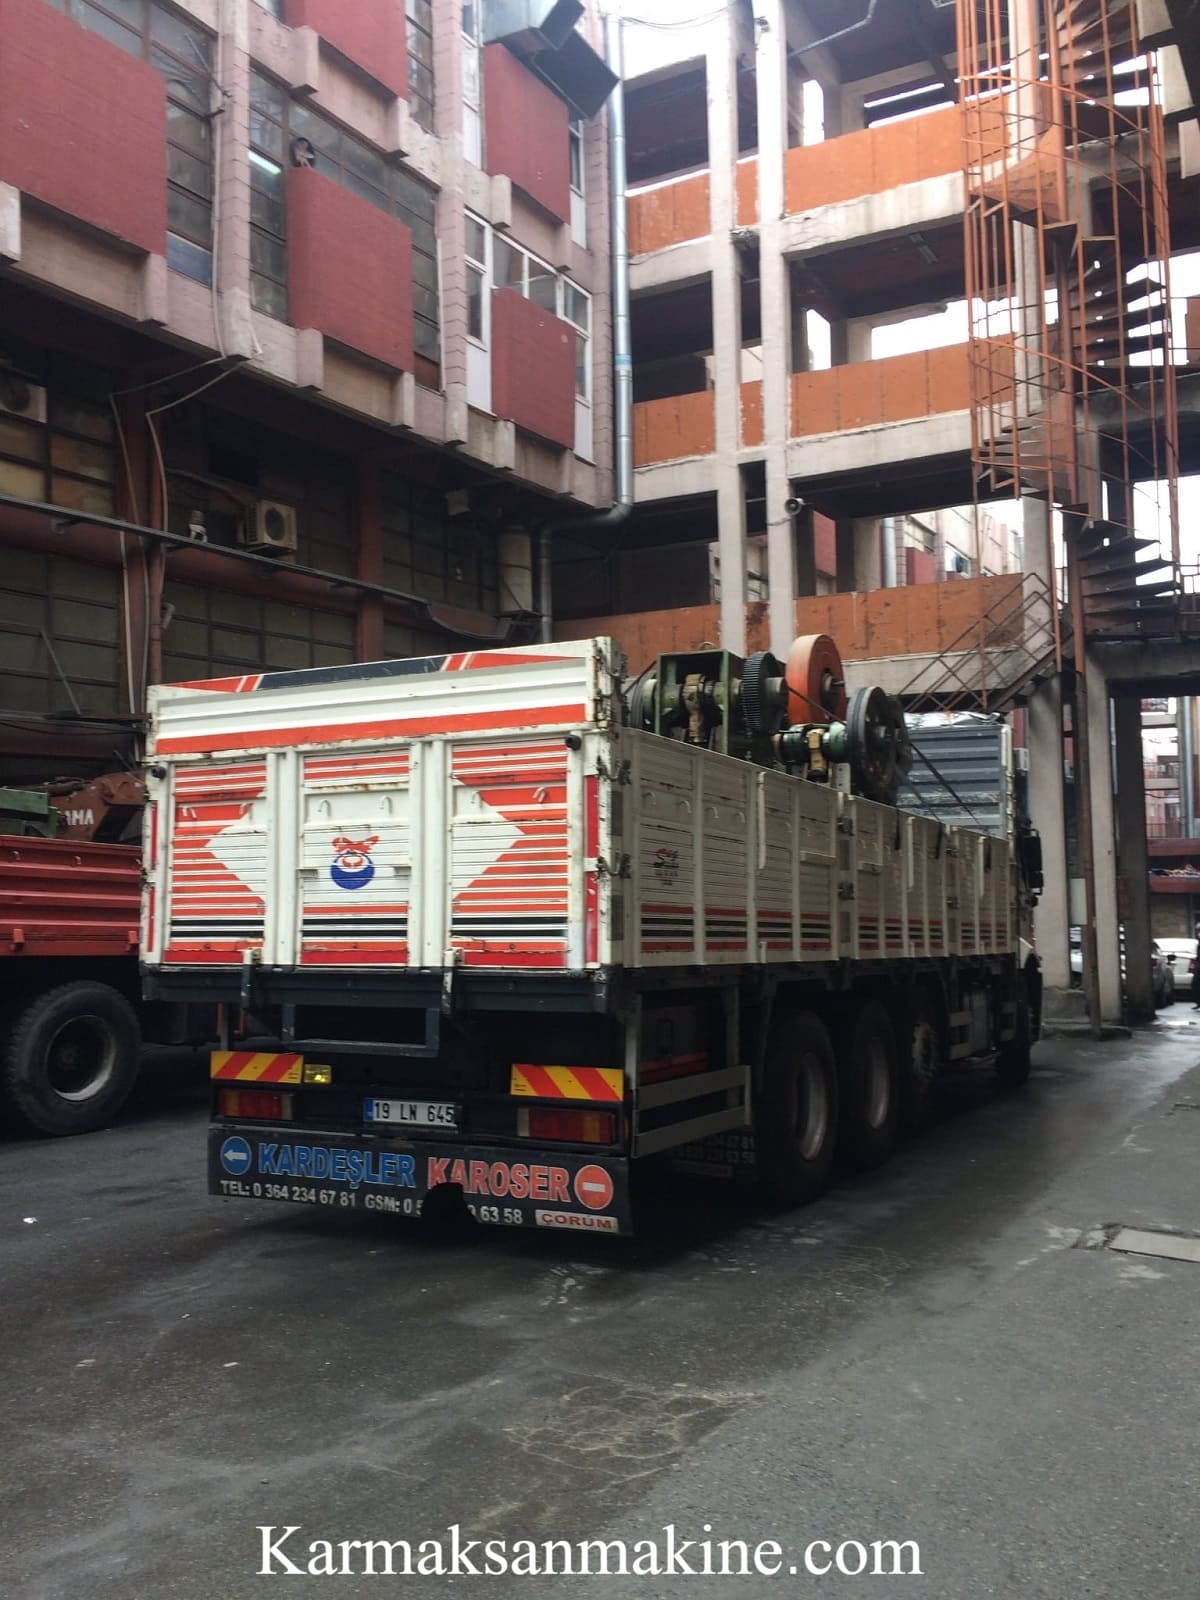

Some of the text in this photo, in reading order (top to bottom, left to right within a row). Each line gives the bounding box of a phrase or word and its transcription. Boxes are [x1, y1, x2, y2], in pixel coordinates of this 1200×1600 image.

[375, 1102, 390, 1120] 19
[427, 1105, 455, 1123] 645
[258, 1142, 572, 1203] KARDEŞLER KAROSER
[220, 1179, 250, 1197] TEL:
[253, 1182, 263, 1198] 0
[266, 1183, 290, 1200] 364
[292, 1186, 317, 1204] 234
[319, 1189, 337, 1206] 67
[340, 1191, 357, 1208] 81
[364, 1193, 401, 1213] GSM:
[403, 1198, 413, 1214] 0
[480, 1205, 500, 1223] 63
[503, 1207, 524, 1225] 58
